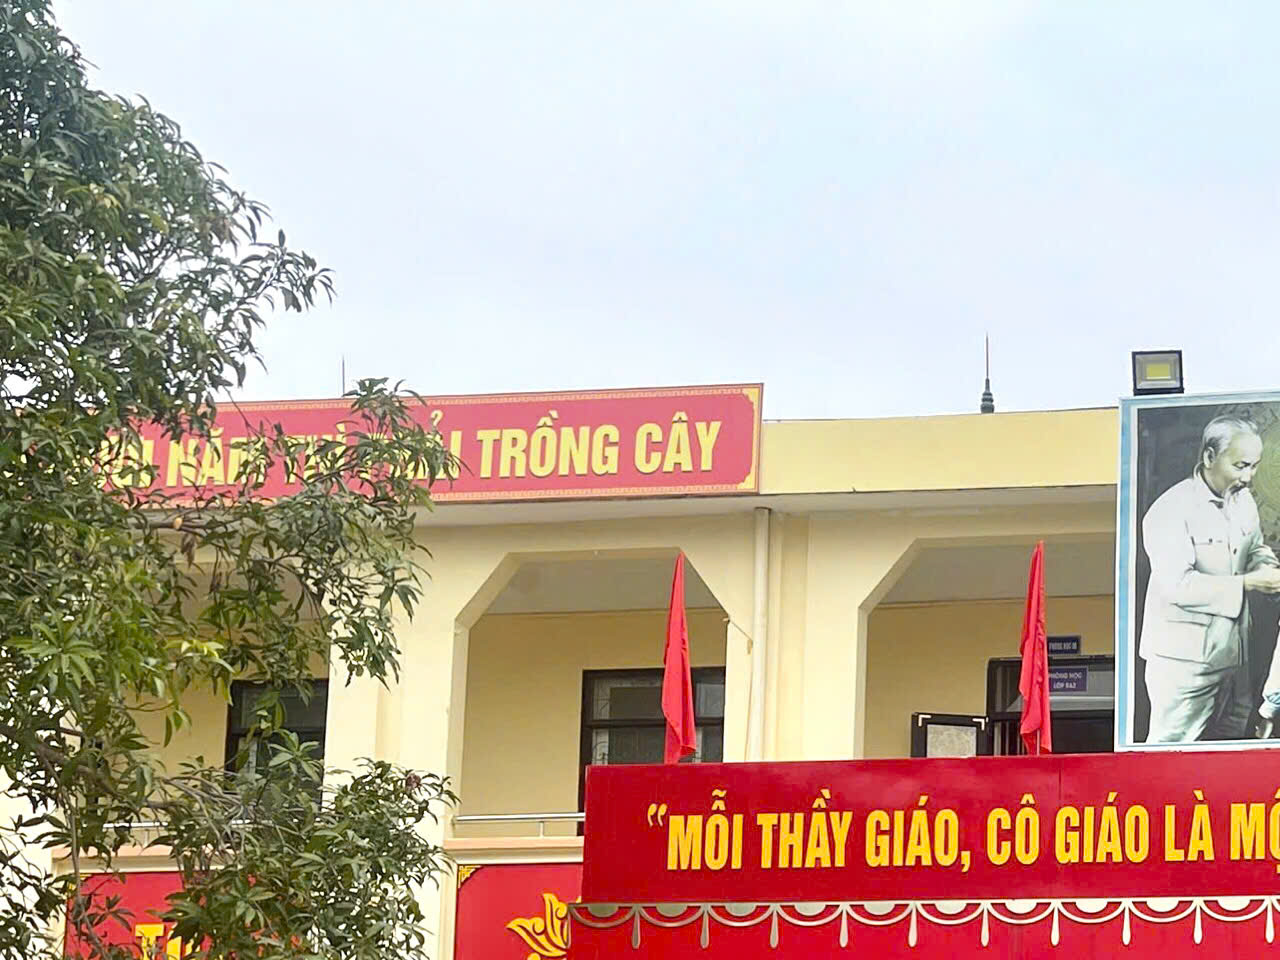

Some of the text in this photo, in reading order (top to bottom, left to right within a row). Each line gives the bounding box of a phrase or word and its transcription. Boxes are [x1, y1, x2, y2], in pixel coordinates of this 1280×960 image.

[476, 410, 620, 478] TRỒNG
[634, 411, 722, 474] CÂY
[757, 789, 852, 868] THẦY
[866, 796, 970, 872] GIÁO,
[987, 794, 1039, 865] CÔ
[1056, 792, 1149, 863] GIÁO
[1165, 790, 1214, 861] LÀ
